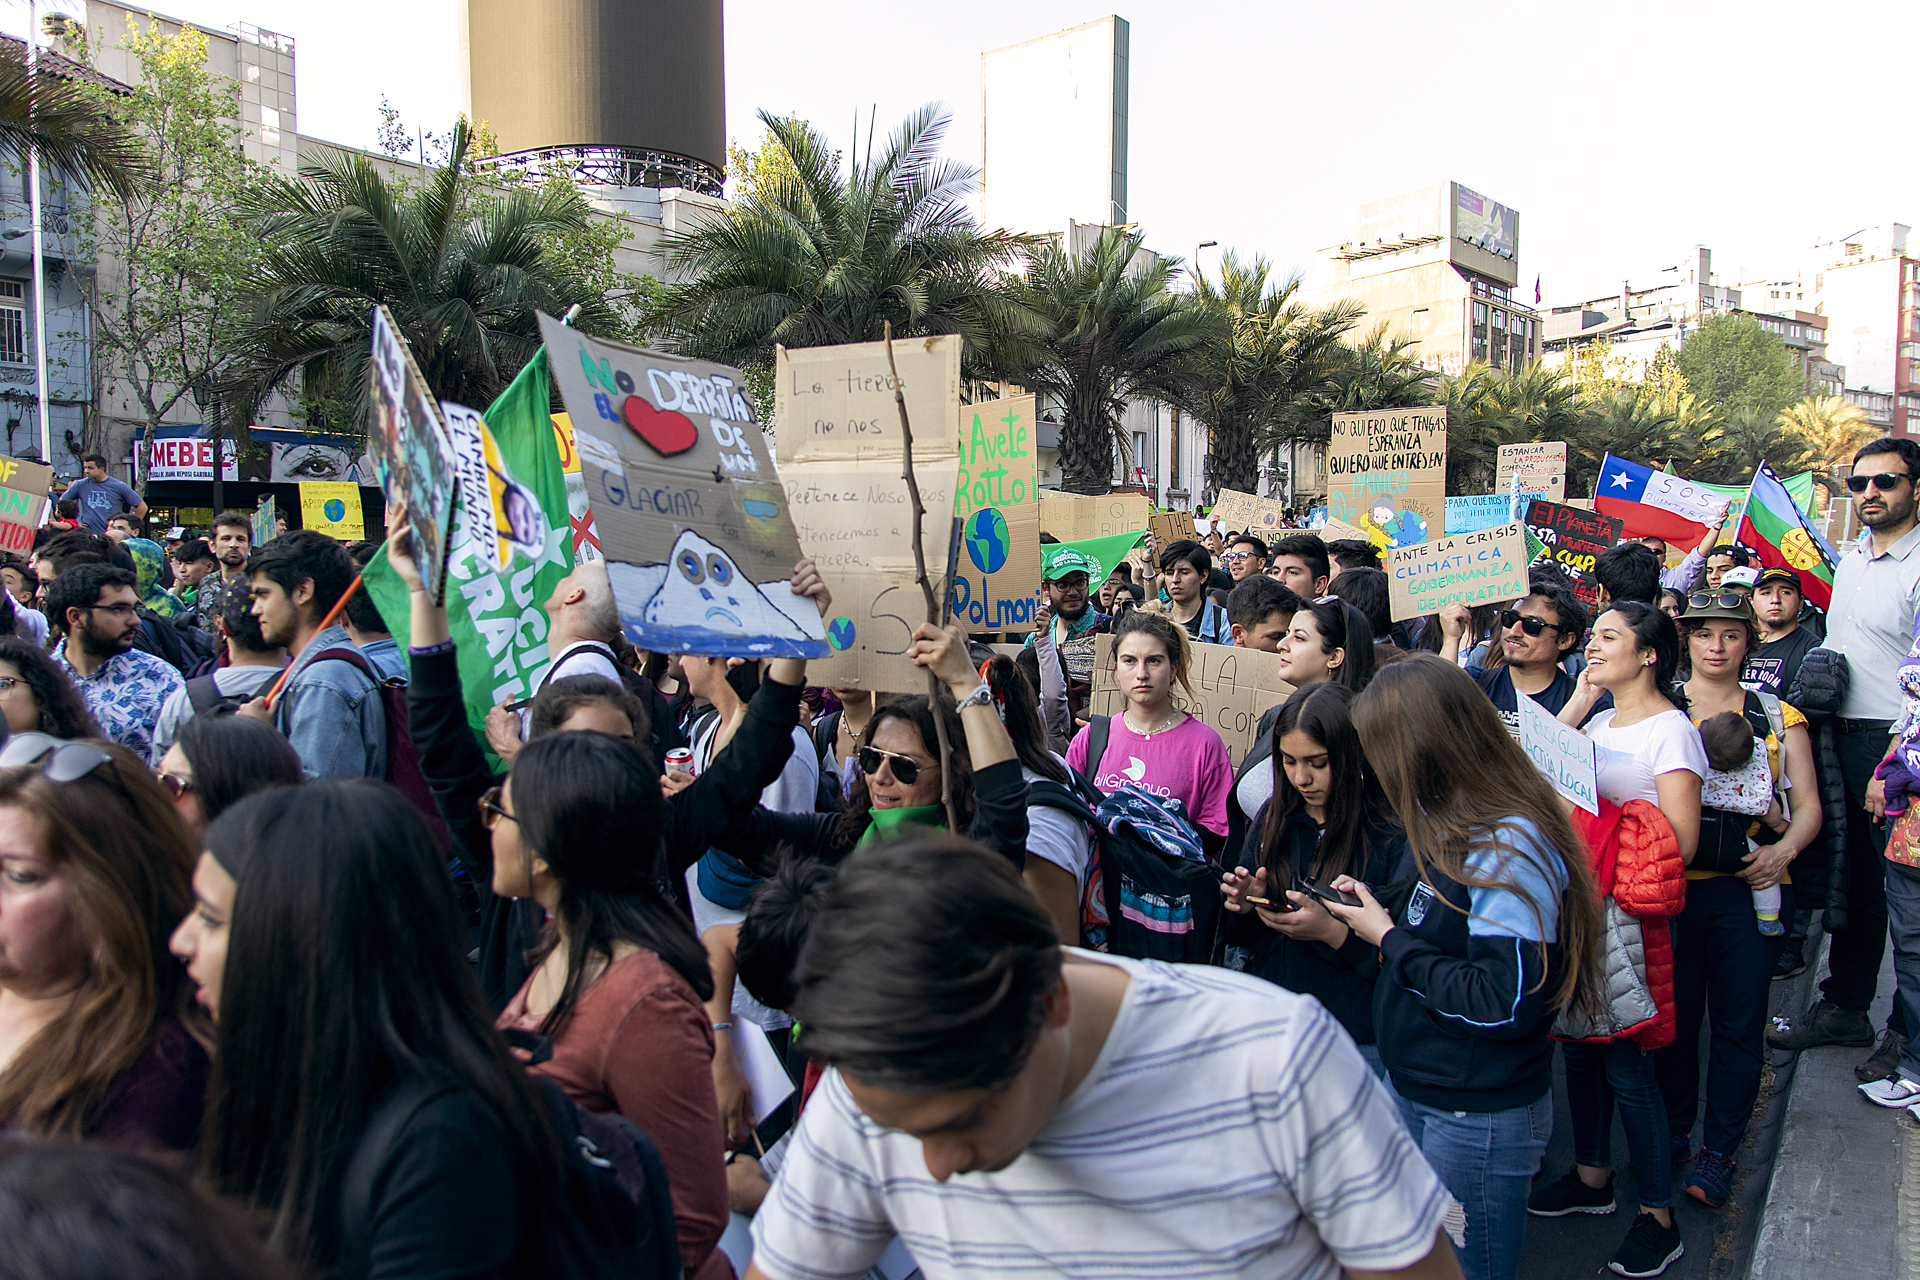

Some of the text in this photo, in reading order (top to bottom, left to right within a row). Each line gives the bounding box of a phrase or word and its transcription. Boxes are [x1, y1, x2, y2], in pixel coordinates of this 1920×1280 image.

[793, 370, 825, 396] La
[594, 392, 754, 455] EL DE
[814, 418, 883, 435] no nos
[1333, 415, 1446, 438] NO QUIERO QUE TENGAS
[1368, 433, 1422, 453] ESPERANZA
[1502, 446, 1545, 457] ESTANCAR
[718, 451, 758, 473] UN
[1330, 451, 1444, 475] QUIERO QUE ENTRES EN
[1501, 463, 1535, 472] COMENZAR
[450, 413, 483, 543] EL MUNDO
[466, 412, 496, 561] CAMBIEMOS
[1353, 470, 1409, 500] PÁNICO
[1041, 502, 1061, 521] uida
[1489, 496, 1502, 505] NOS
[1645, 491, 1709, 522] QUINTERO
[1164, 512, 1191, 536] THE
[1268, 532, 1281, 542] NO
[1393, 546, 1428, 563] ANTE
[1438, 540, 1454, 552] LA
[1466, 524, 1517, 545] CRISIS
[1396, 546, 1502, 579] CLIMÁTICA
[1408, 561, 1514, 594] GOBERNANZA
[1418, 580, 1523, 611] DEMOCRÁTICA
[1201, 651, 1238, 695] LA
[1743, 669, 1758, 681] ER
[1560, 760, 1597, 807] LOCAL
